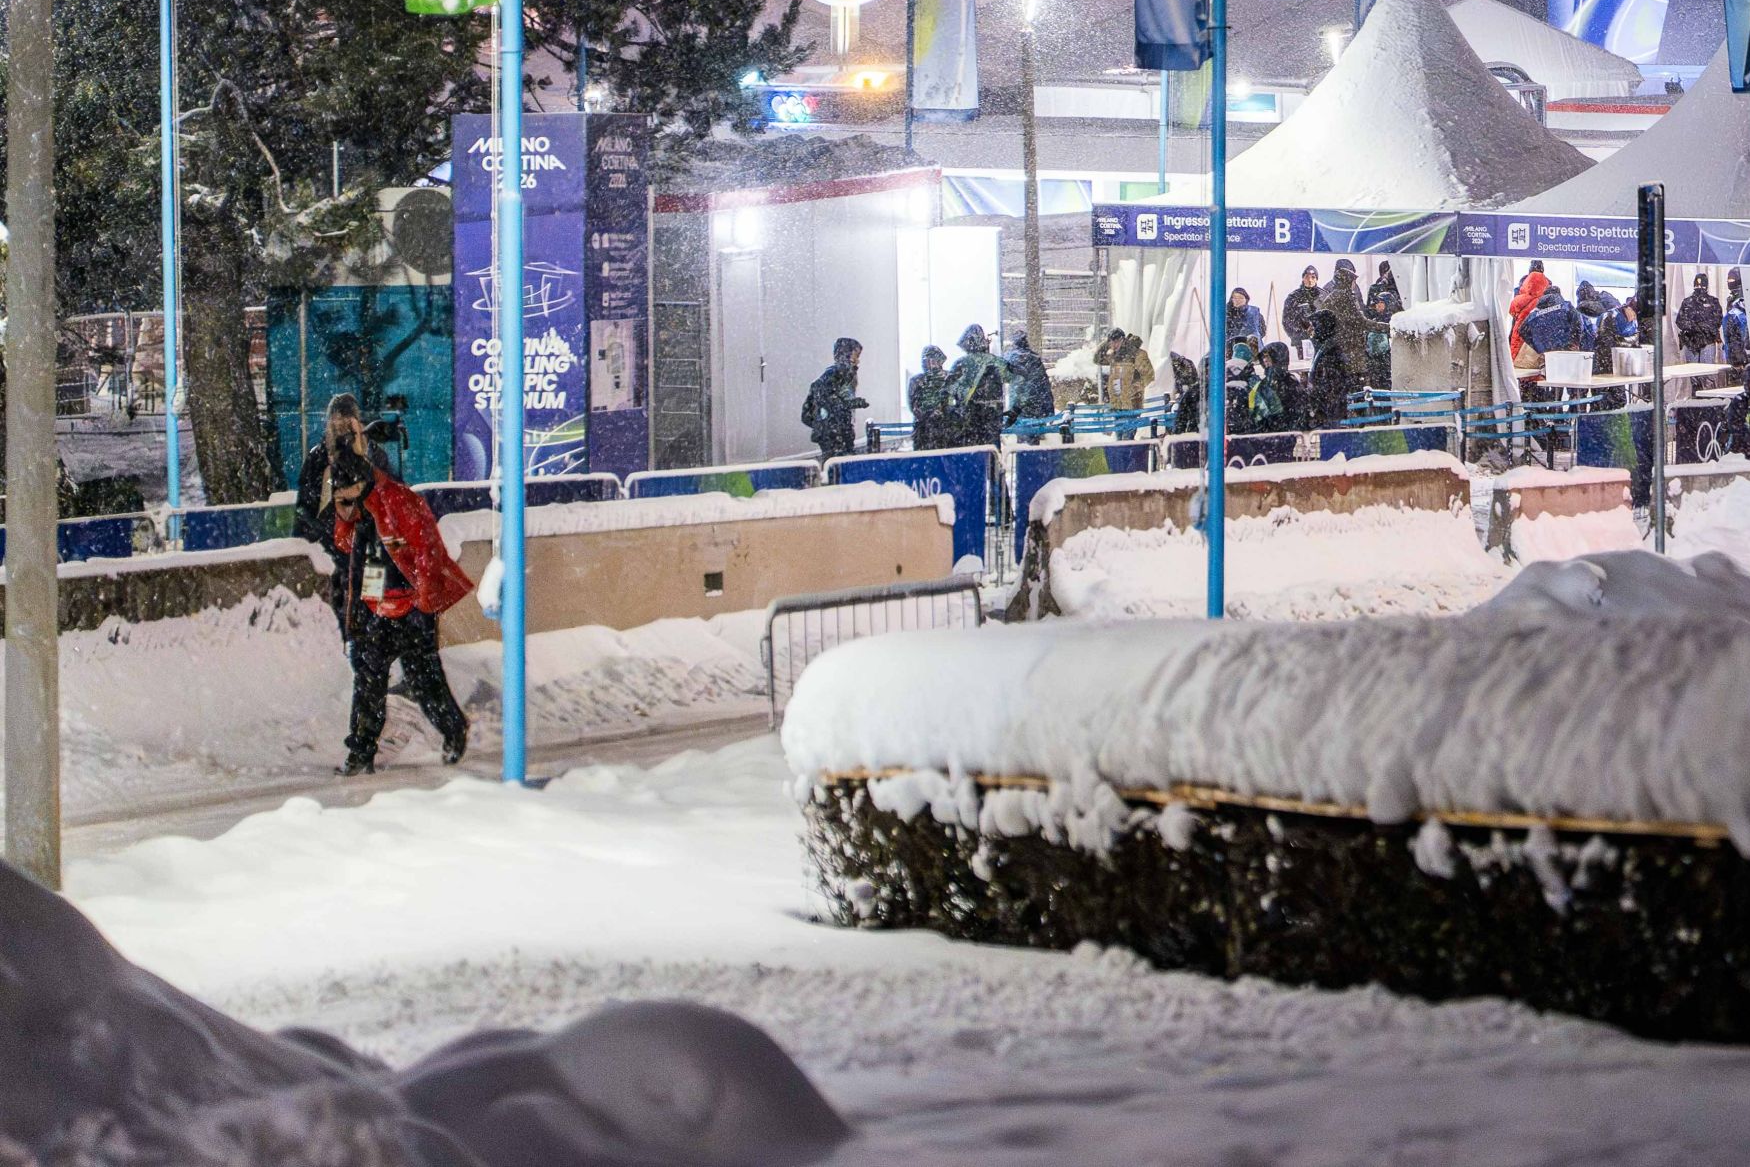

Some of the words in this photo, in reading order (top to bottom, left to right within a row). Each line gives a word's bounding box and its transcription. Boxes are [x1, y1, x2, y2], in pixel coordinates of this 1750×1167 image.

[1164, 214, 1211, 229] Ingresso
[1226, 215, 1267, 229] ettatori
[1274, 218, 1291, 244] B
[1164, 232, 1203, 242] Spectator
[1537, 224, 1588, 239] Ingresso
[1589, 226, 1639, 240] Spettato
[1537, 242, 1580, 253] Spectator
[1581, 243, 1621, 254] Entrance
[471, 337, 561, 356] COTINA
[483, 355, 571, 374] CLING
[474, 391, 567, 410] STIUM
[898, 476, 942, 499] ANO
